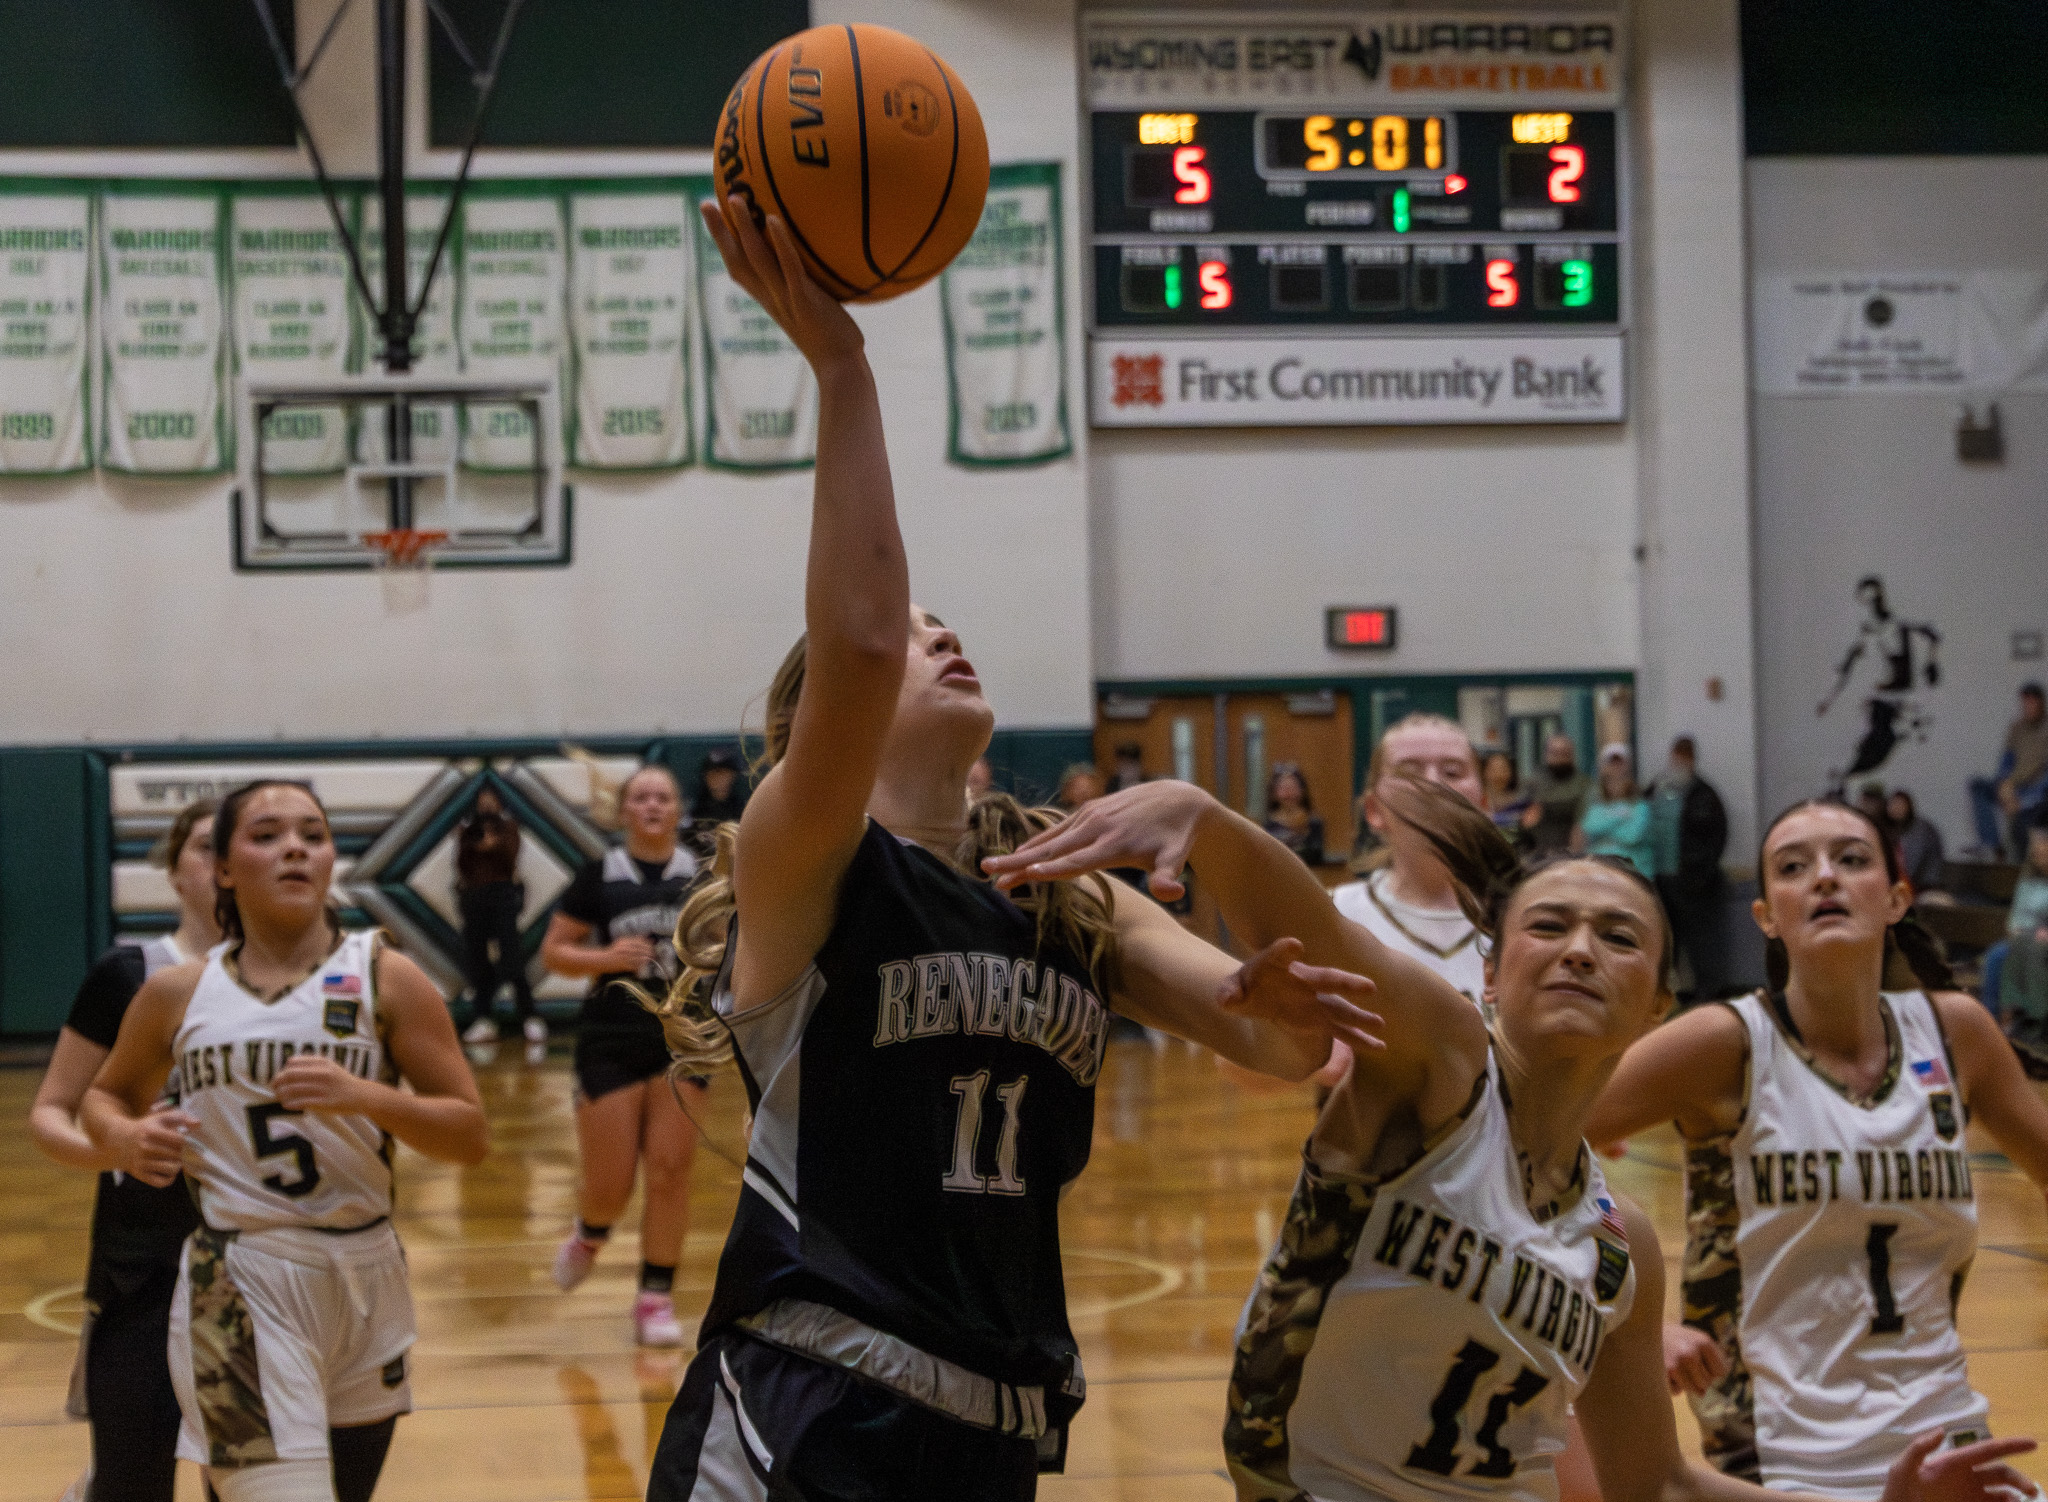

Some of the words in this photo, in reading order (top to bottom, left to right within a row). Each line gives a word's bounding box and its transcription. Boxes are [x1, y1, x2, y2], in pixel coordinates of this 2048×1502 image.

[1090, 38, 1237, 70] WYOMING
[1248, 37, 1336, 70] EAST
[1386, 23, 1613, 53] WARRIOR
[1390, 64, 1606, 92] BASKETBALL
[1303, 115, 1442, 172] 5:01
[1173, 146, 1211, 204] 5
[1548, 145, 1585, 203] 2
[1199, 260, 1232, 309] 5
[1486, 259, 1519, 307] 5
[1562, 259, 1593, 307] 3
[1178, 359, 1257, 400] First
[1269, 355, 1501, 406] Community
[1512, 355, 1606, 400] Bank
[246, 1100, 321, 1197] 5
[942, 1068, 1026, 1196] 11
[1751, 1151, 1843, 1202] WEST
[1375, 1200, 1500, 1303] WEST
[1866, 1222, 1904, 1333] 1
[1404, 1335, 1550, 1479] 11
